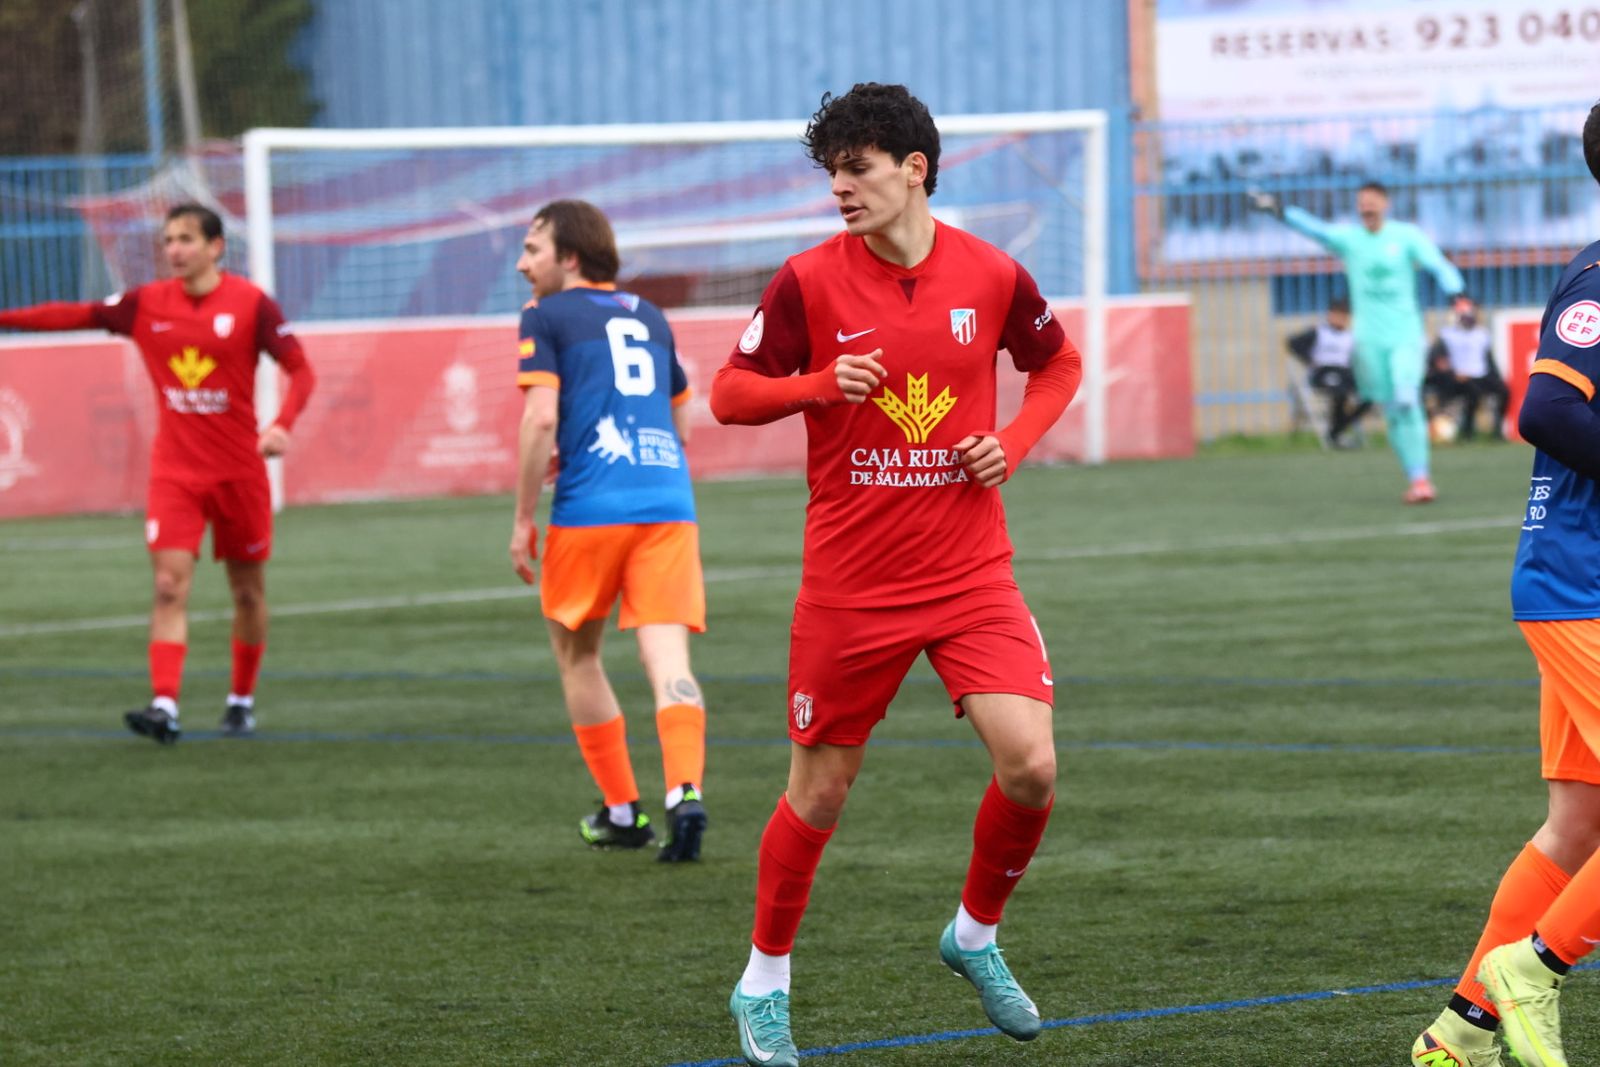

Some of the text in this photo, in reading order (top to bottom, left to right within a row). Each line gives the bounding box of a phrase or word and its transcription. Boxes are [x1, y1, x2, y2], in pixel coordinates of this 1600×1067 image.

[1415, 12, 1499, 49] 923
[605, 317, 656, 397] 6
[850, 448, 962, 471] CAJA RURA
[850, 468, 969, 487] DE SALAMANCA
[1528, 485, 1551, 500] ES
